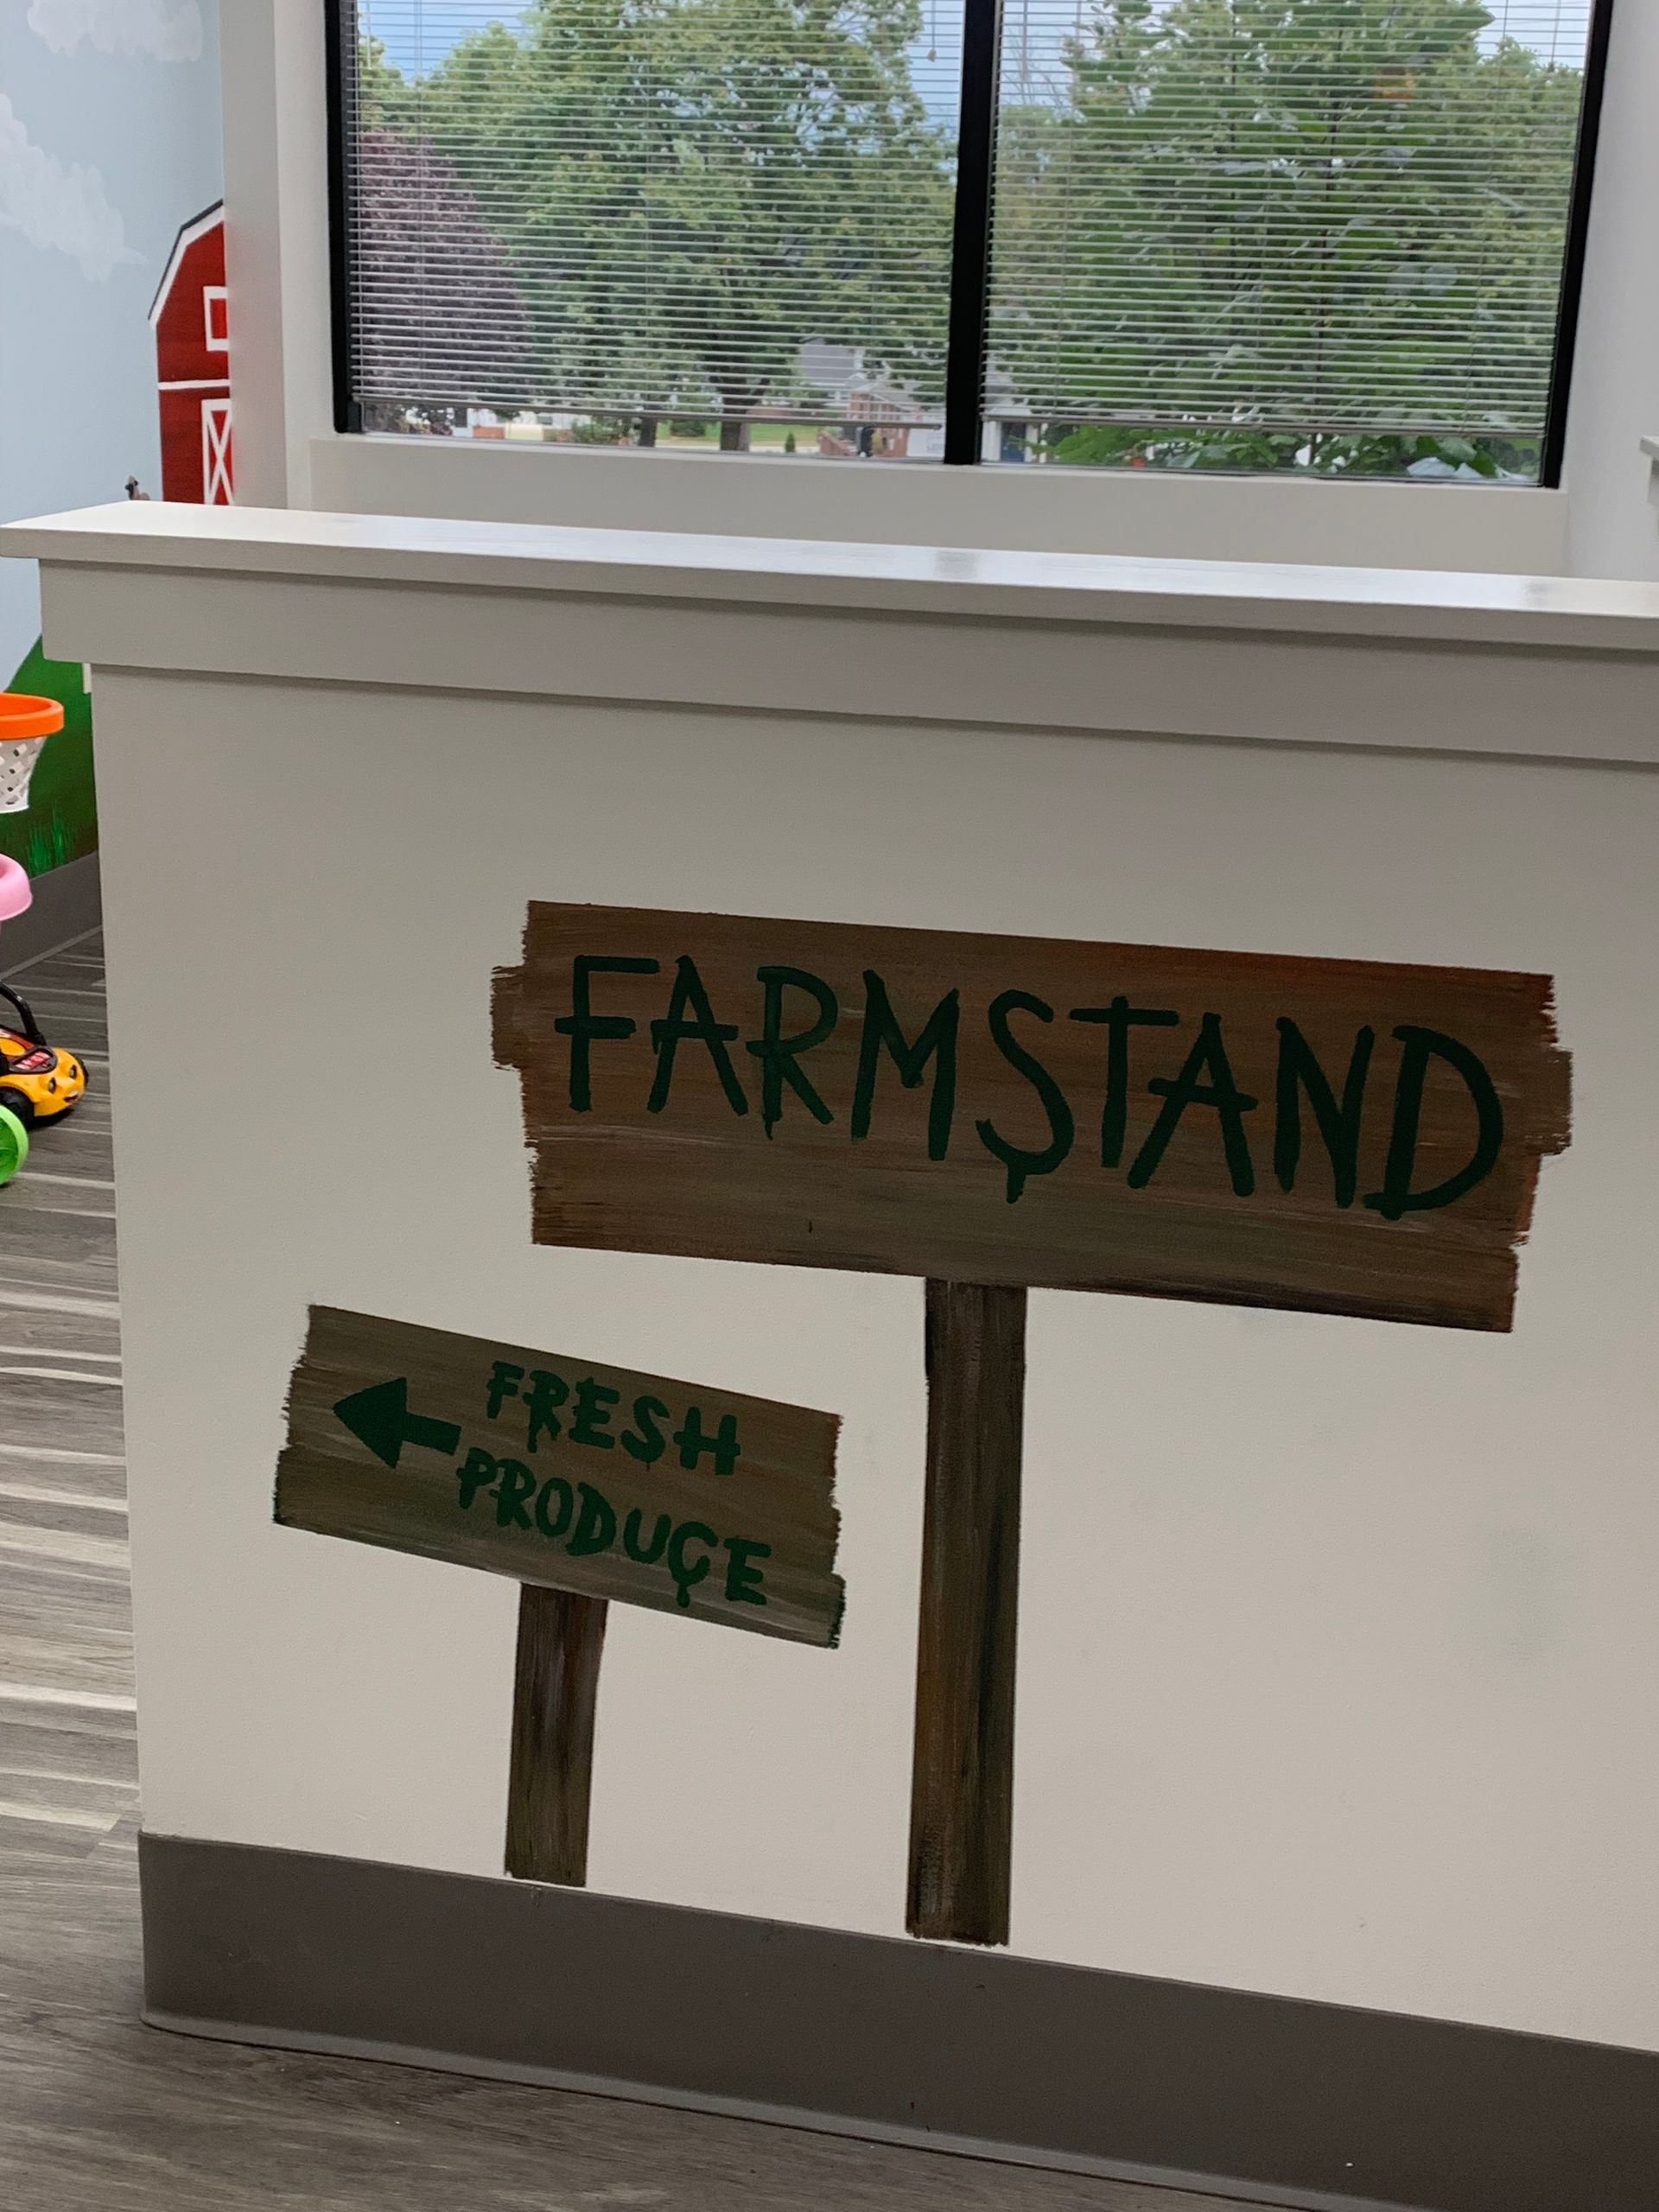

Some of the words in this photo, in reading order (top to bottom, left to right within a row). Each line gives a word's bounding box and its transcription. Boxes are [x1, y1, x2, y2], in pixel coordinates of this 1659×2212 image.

[555, 955, 1503, 1220] FARMSTAND
[486, 1360, 741, 1476] FRESH
[456, 1447, 772, 1608] PRODUCE
